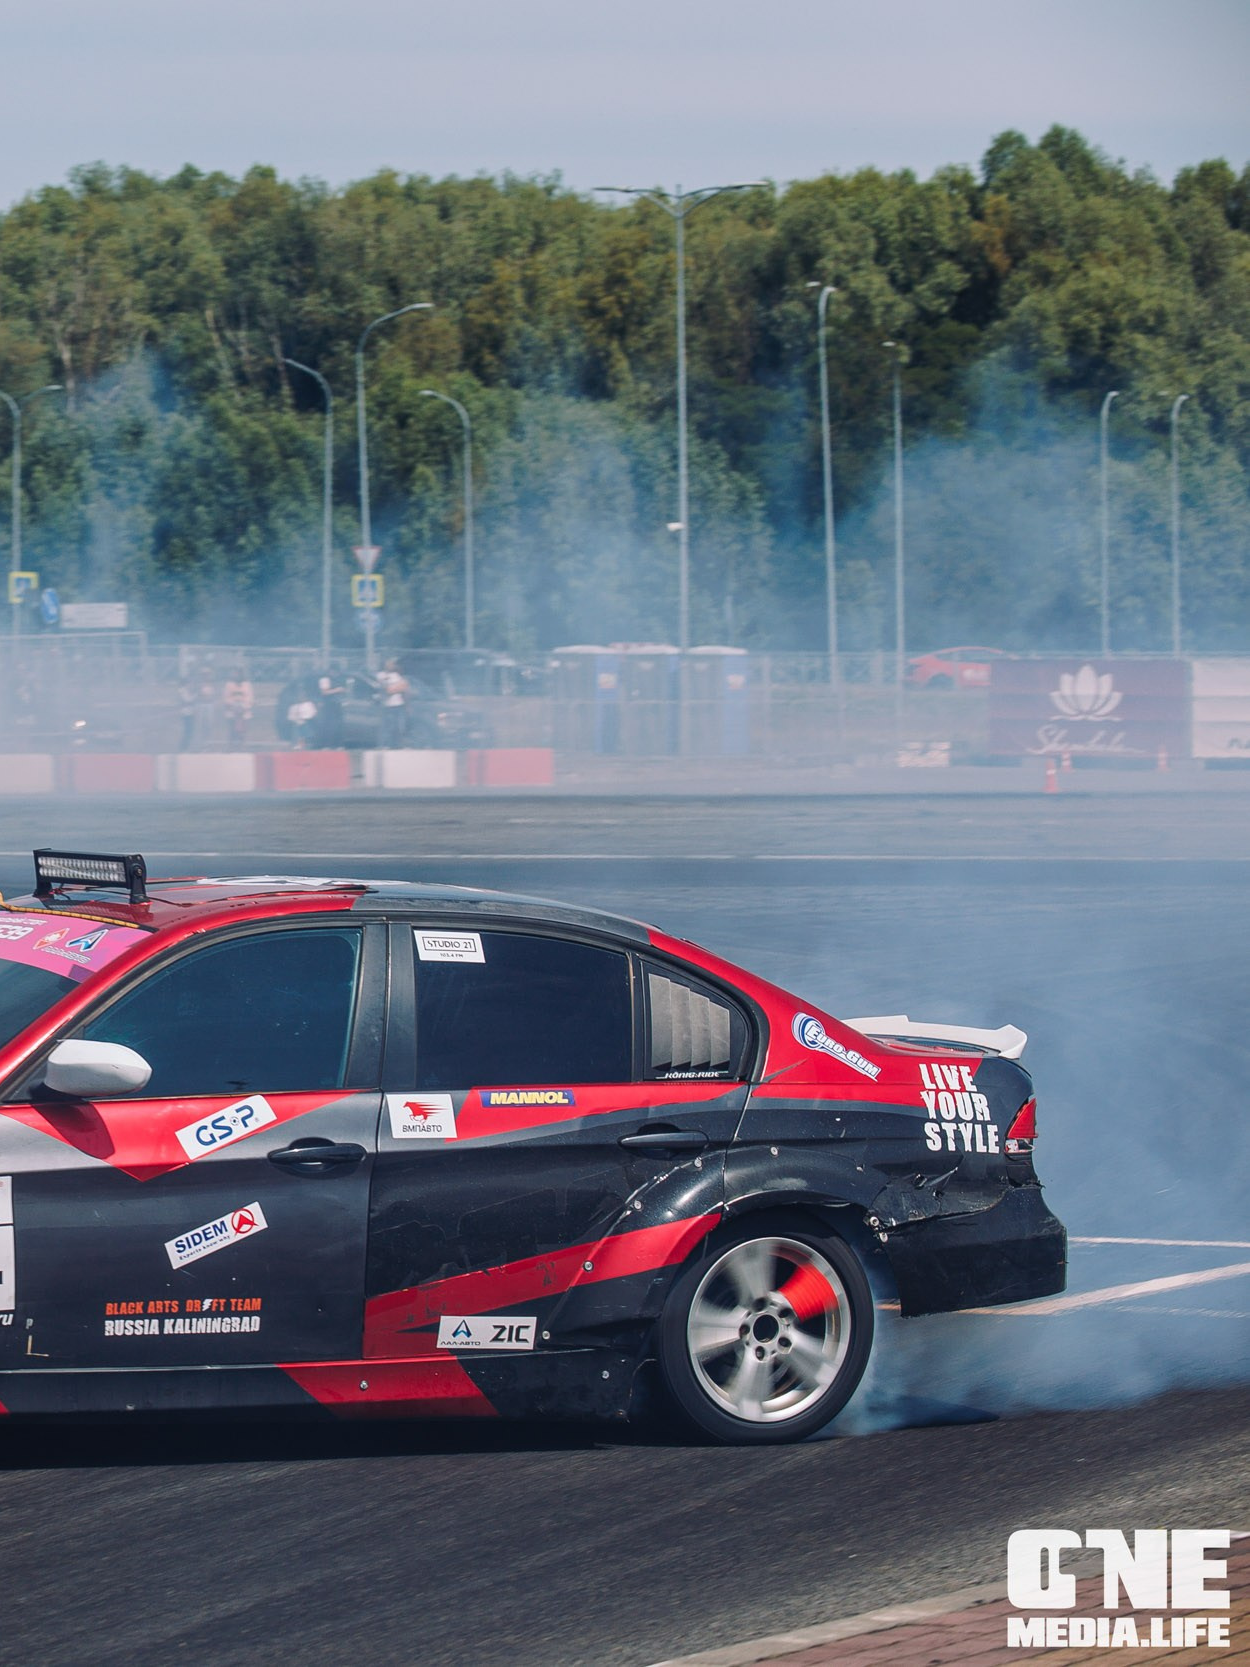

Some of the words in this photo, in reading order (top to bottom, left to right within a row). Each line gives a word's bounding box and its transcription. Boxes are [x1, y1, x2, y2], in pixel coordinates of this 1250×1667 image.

[427, 940, 461, 948] STUDIO
[463, 941, 472, 949] 21
[919, 1063, 978, 1092] LIVE
[489, 1091, 569, 1105] MANNOL
[920, 1090, 991, 1122] YOUR
[402, 1124, 443, 1133] ВМПАВТО
[923, 1122, 1000, 1154] STYLE
[174, 1220, 228, 1253] SIDEM
[105, 1301, 144, 1316] BLACK
[147, 1300, 179, 1313] ARTS
[230, 1298, 262, 1312] TEAM
[104, 1318, 160, 1336] RUSSIA
[163, 1315, 261, 1335] KALININGRAD
[489, 1324, 531, 1344] ZIC
